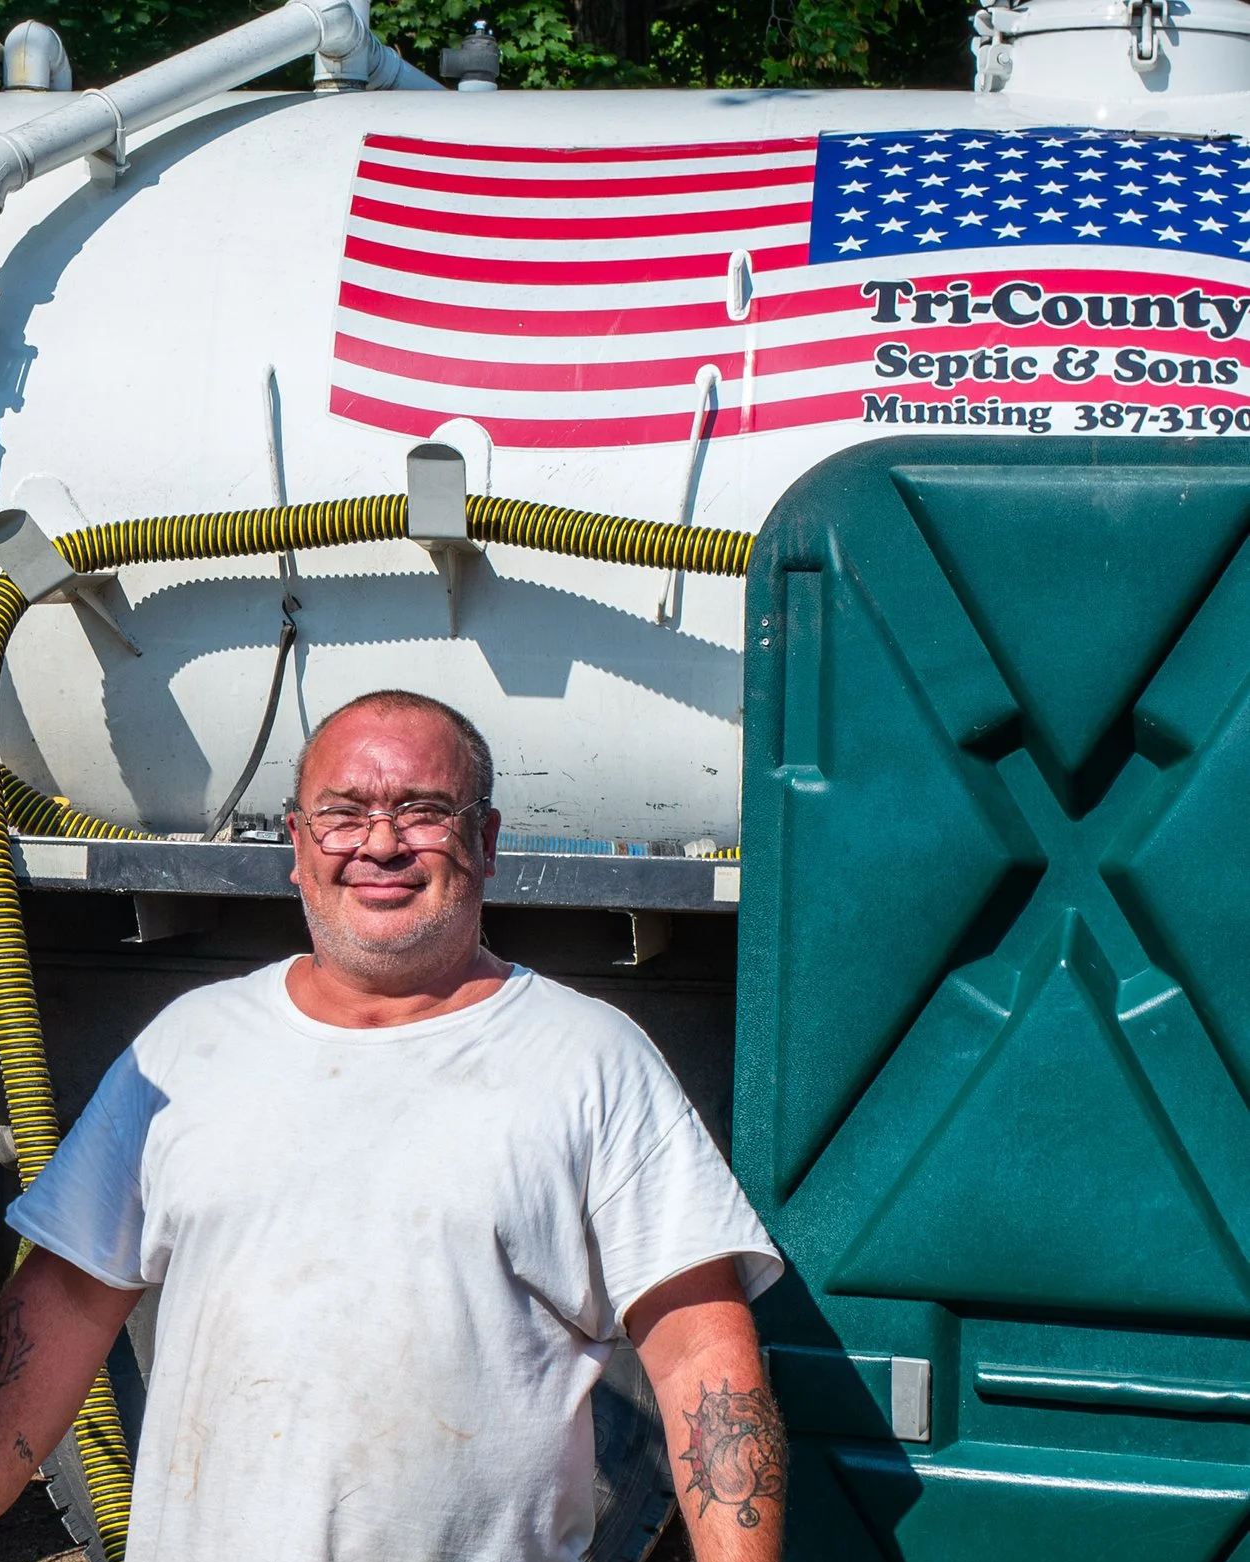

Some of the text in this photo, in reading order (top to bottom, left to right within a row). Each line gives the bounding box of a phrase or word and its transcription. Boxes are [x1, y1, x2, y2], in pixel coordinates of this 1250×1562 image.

[864, 281, 1250, 338] Tri-County
[875, 345, 1238, 386] Septic & Sons
[864, 396, 1250, 434] Munising 387-3190
